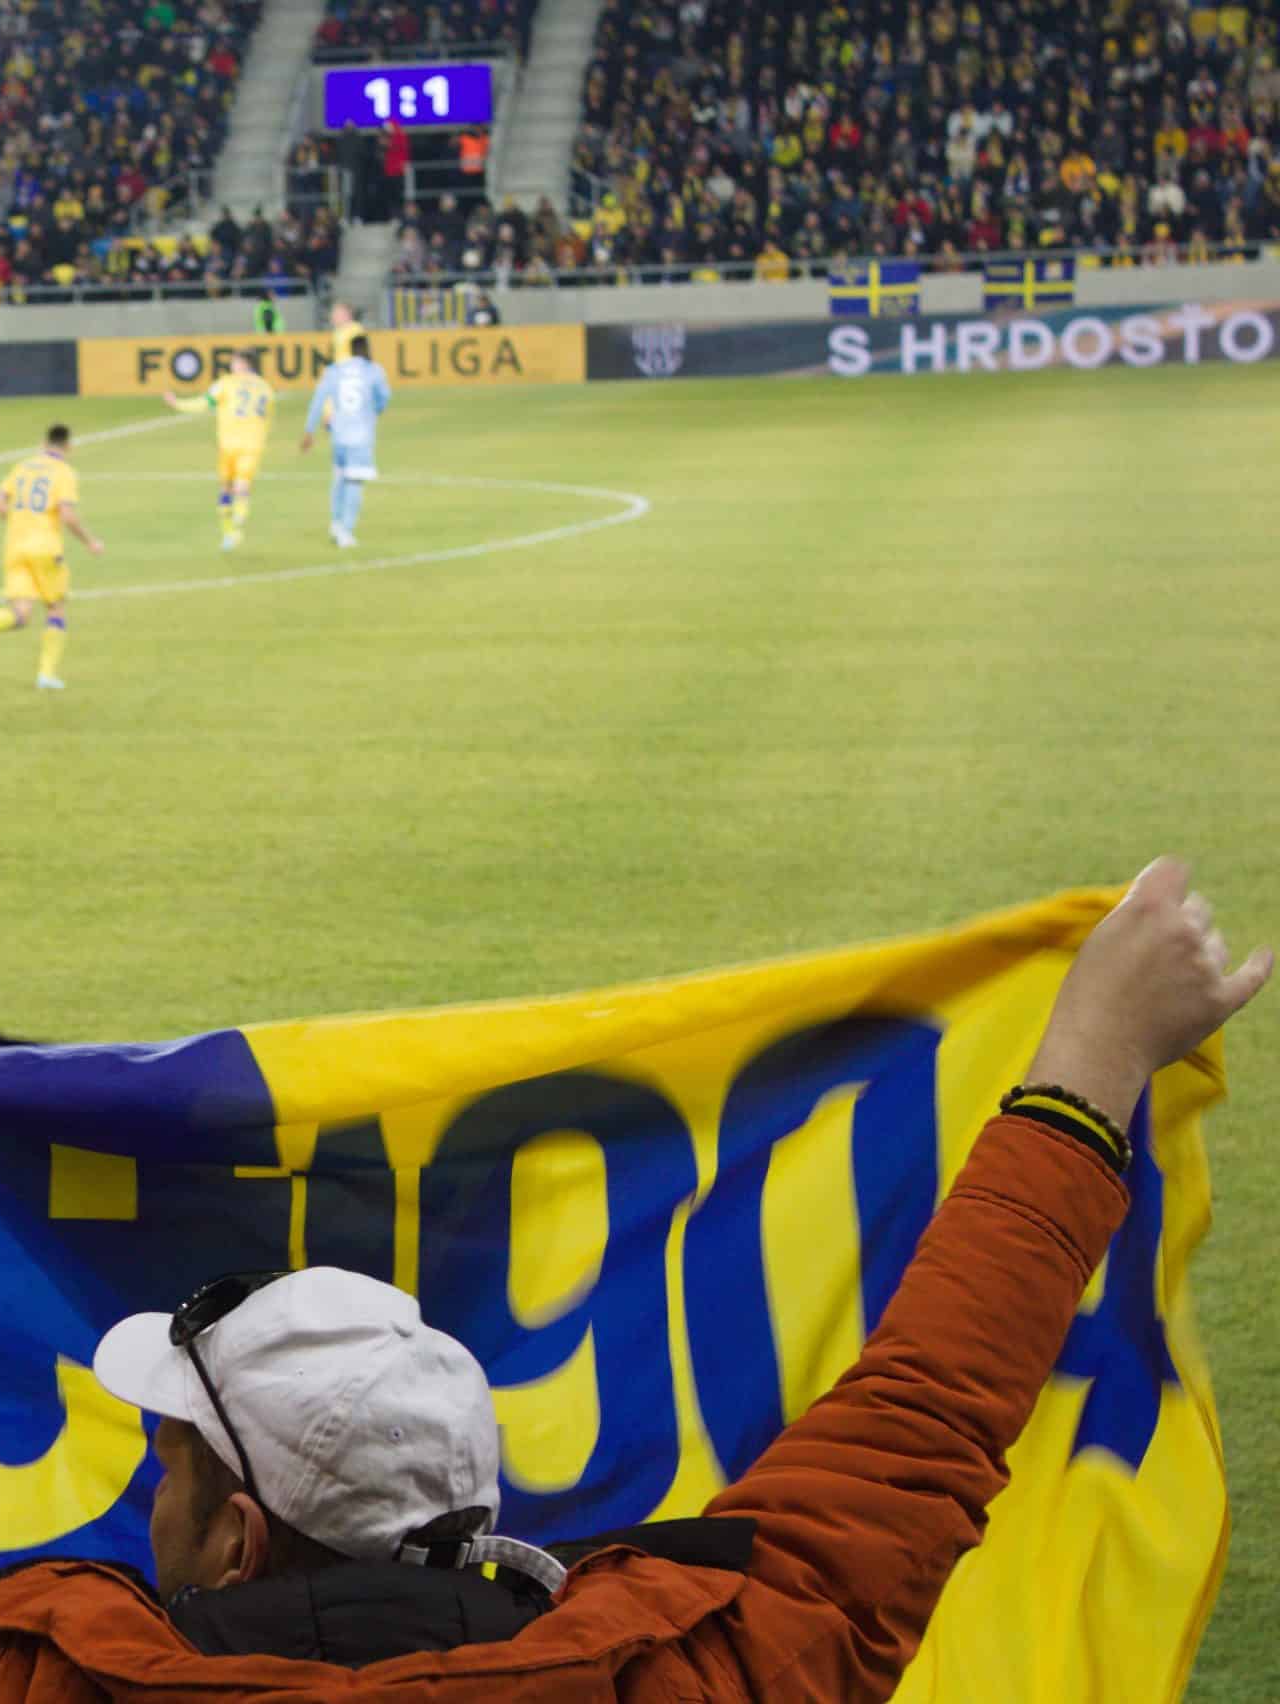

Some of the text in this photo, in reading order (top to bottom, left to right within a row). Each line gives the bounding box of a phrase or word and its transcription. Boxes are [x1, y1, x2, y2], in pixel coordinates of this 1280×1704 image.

[364, 75, 449, 118] 1:1
[138, 337, 524, 382] FORTUN LIGA
[828, 324, 871, 376] S
